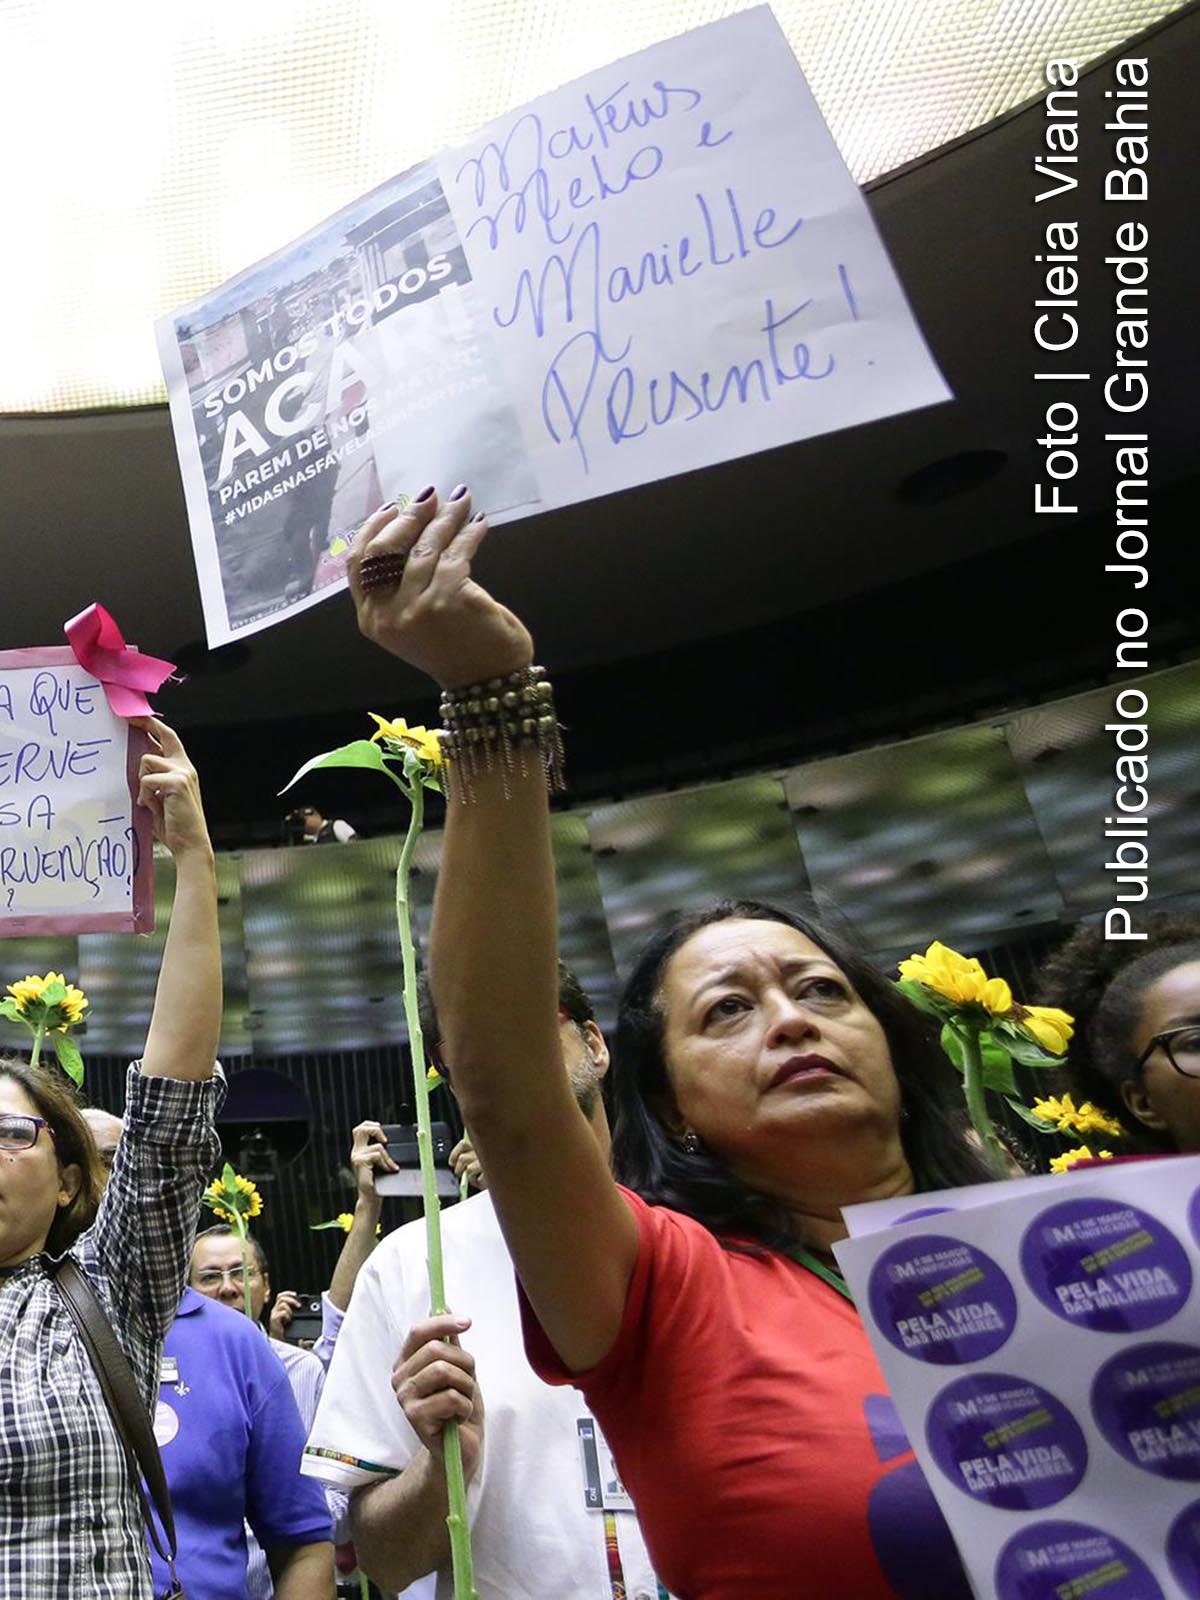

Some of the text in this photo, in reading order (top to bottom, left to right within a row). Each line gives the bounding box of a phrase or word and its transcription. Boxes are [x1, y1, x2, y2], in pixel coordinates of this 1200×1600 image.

[456, 80, 701, 210] Mateus
[696, 121, 733, 147] e
[493, 187, 804, 362] Marielle
[205, 333, 320, 420] SOMOS
[325, 253, 453, 337] TODOS
[219, 398, 378, 505] PAREM DE NOS
[30, 672, 100, 736] QUE
[1055, 1267, 1169, 1301] PELA VIDA
[1063, 1284, 1179, 1315] DAS MULHERES
[896, 1302, 996, 1336] PELA VIDA
[902, 1319, 1004, 1348] DAS MULHERES
[960, 1445, 1067, 1476] PELA VIDA
[968, 1461, 1075, 1491] DAS MULHERES
